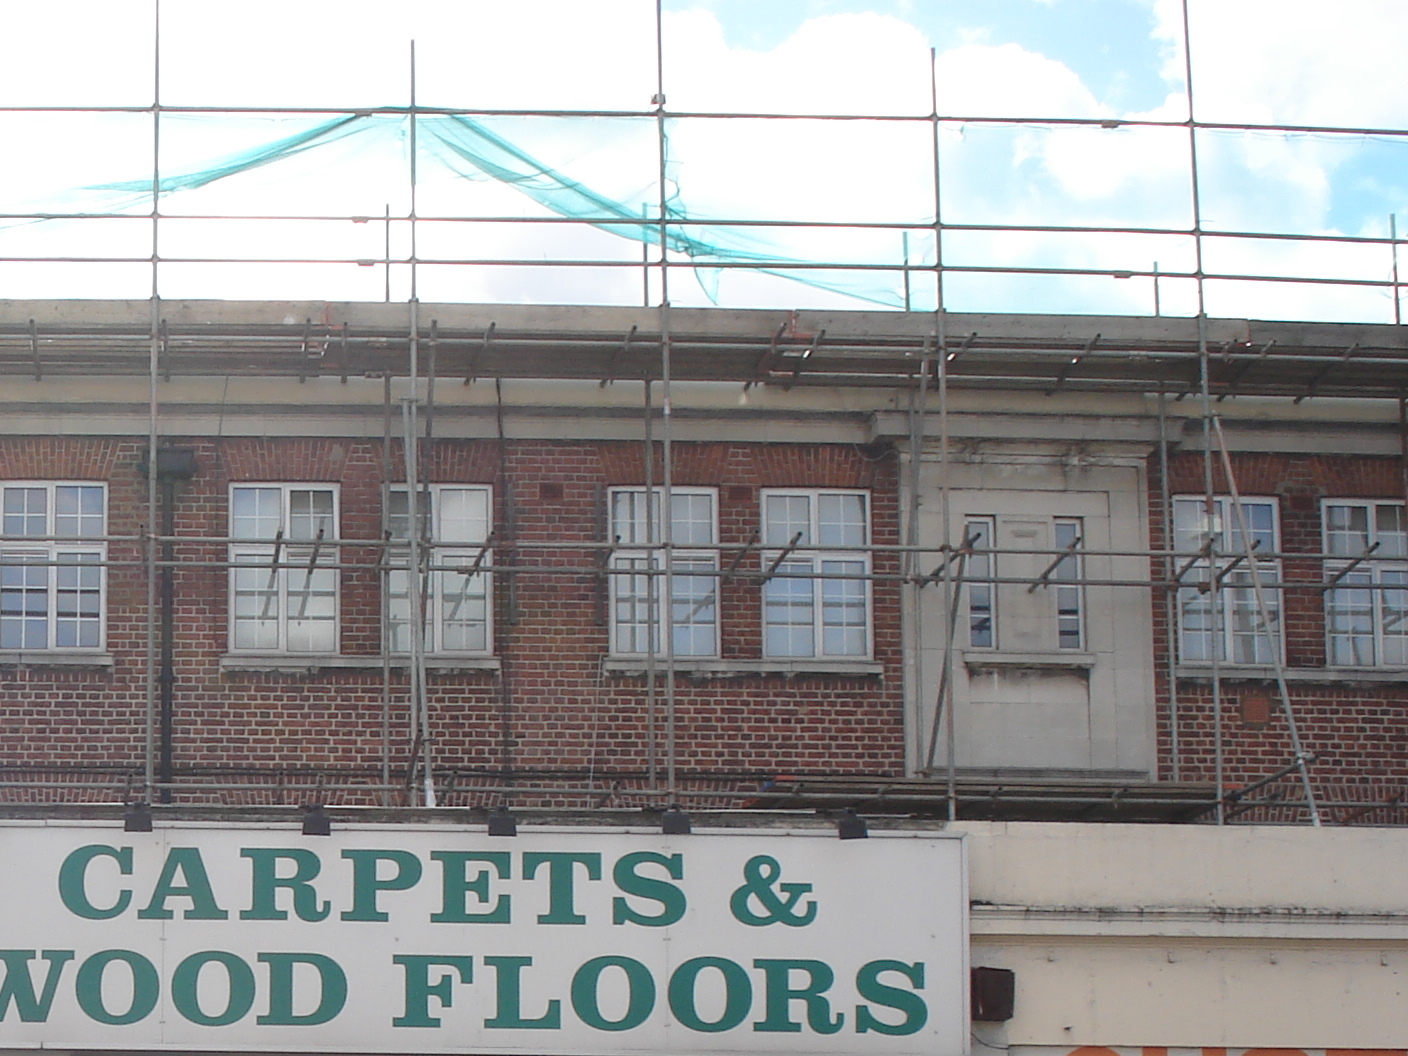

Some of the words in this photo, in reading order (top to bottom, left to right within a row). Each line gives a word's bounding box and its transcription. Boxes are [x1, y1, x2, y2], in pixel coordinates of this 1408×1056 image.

[57, 844, 686, 927] CARPETS
[729, 854, 819, 928] &
[392, 954, 928, 1037] FLOORS
